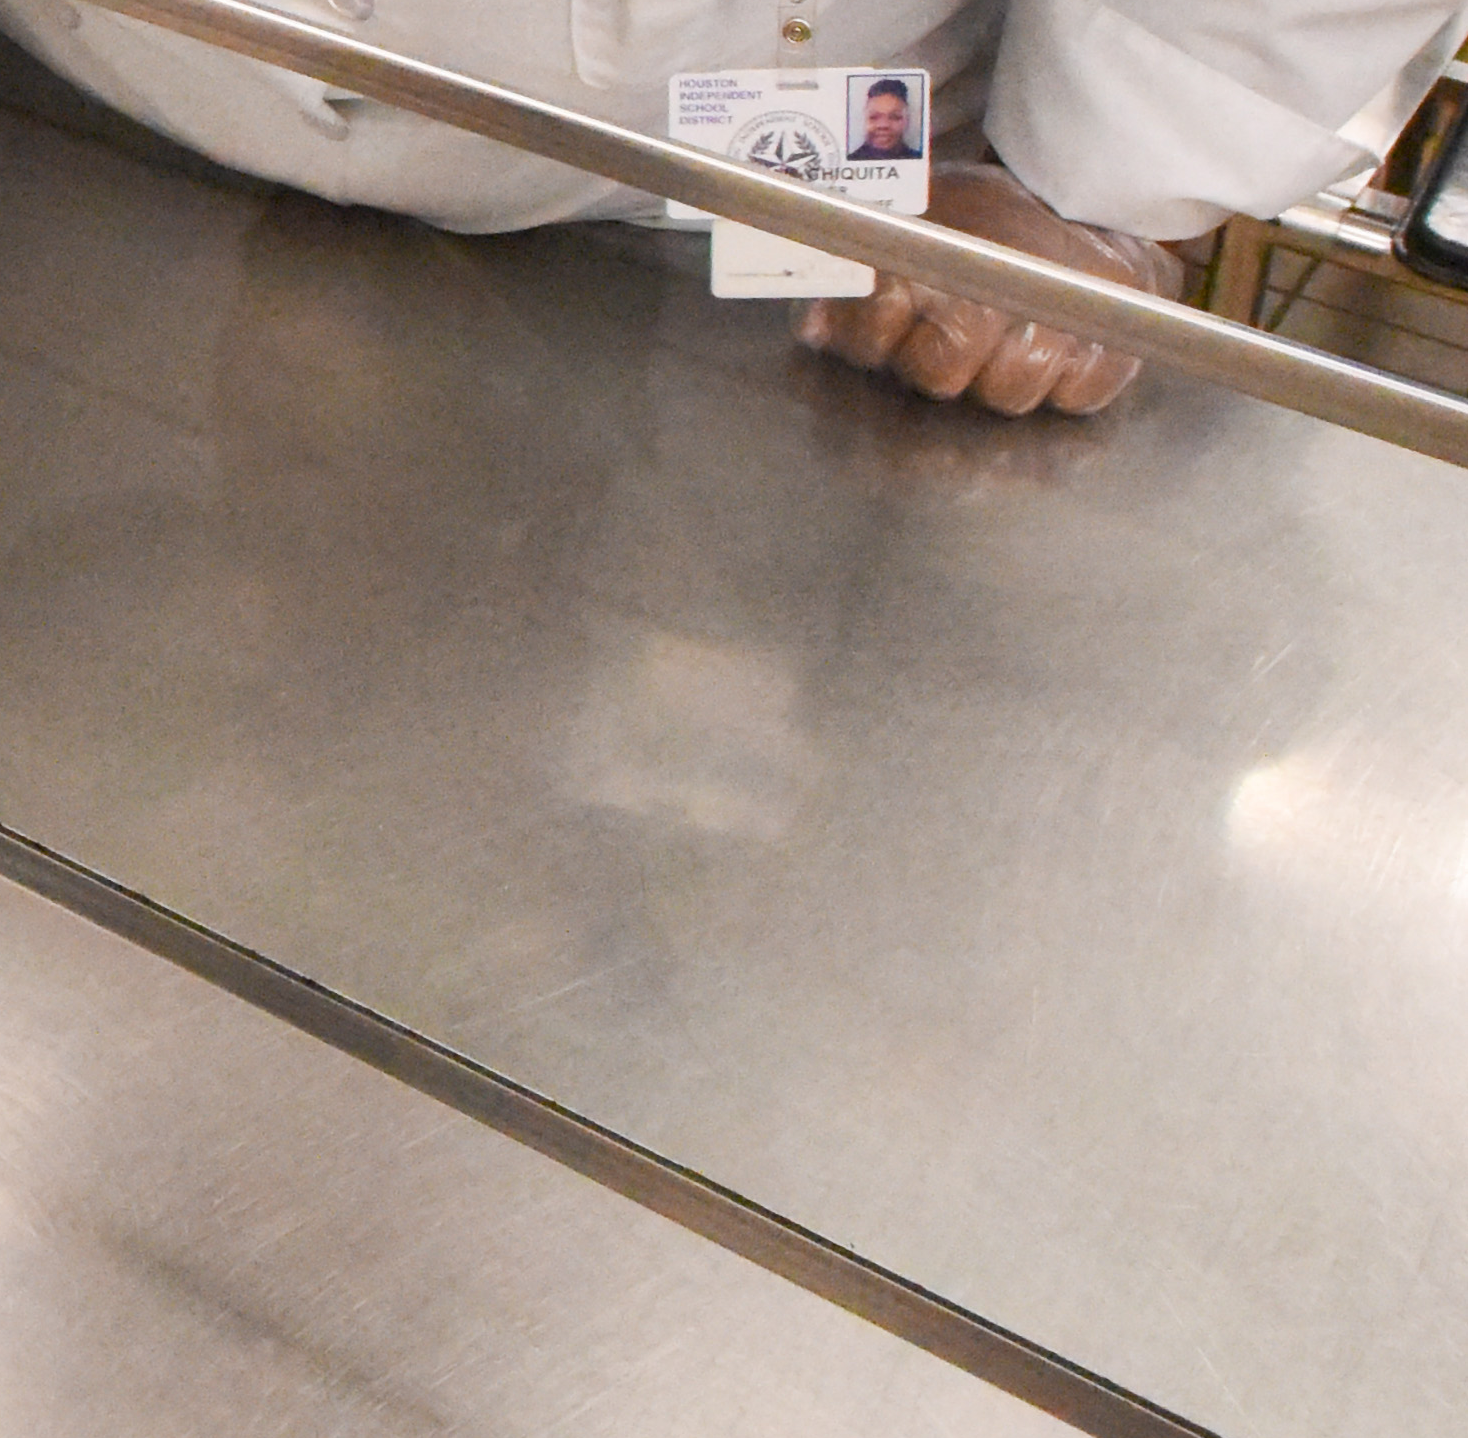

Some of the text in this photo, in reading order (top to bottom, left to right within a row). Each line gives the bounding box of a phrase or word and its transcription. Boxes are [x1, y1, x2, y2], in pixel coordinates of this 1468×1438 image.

[679, 78, 738, 89] HOUSTON
[679, 90, 763, 101] INDEPENDENT
[679, 103, 729, 114] SCHOOL
[679, 115, 733, 126] DISTRICT
[808, 165, 900, 181] CHIQUITA
